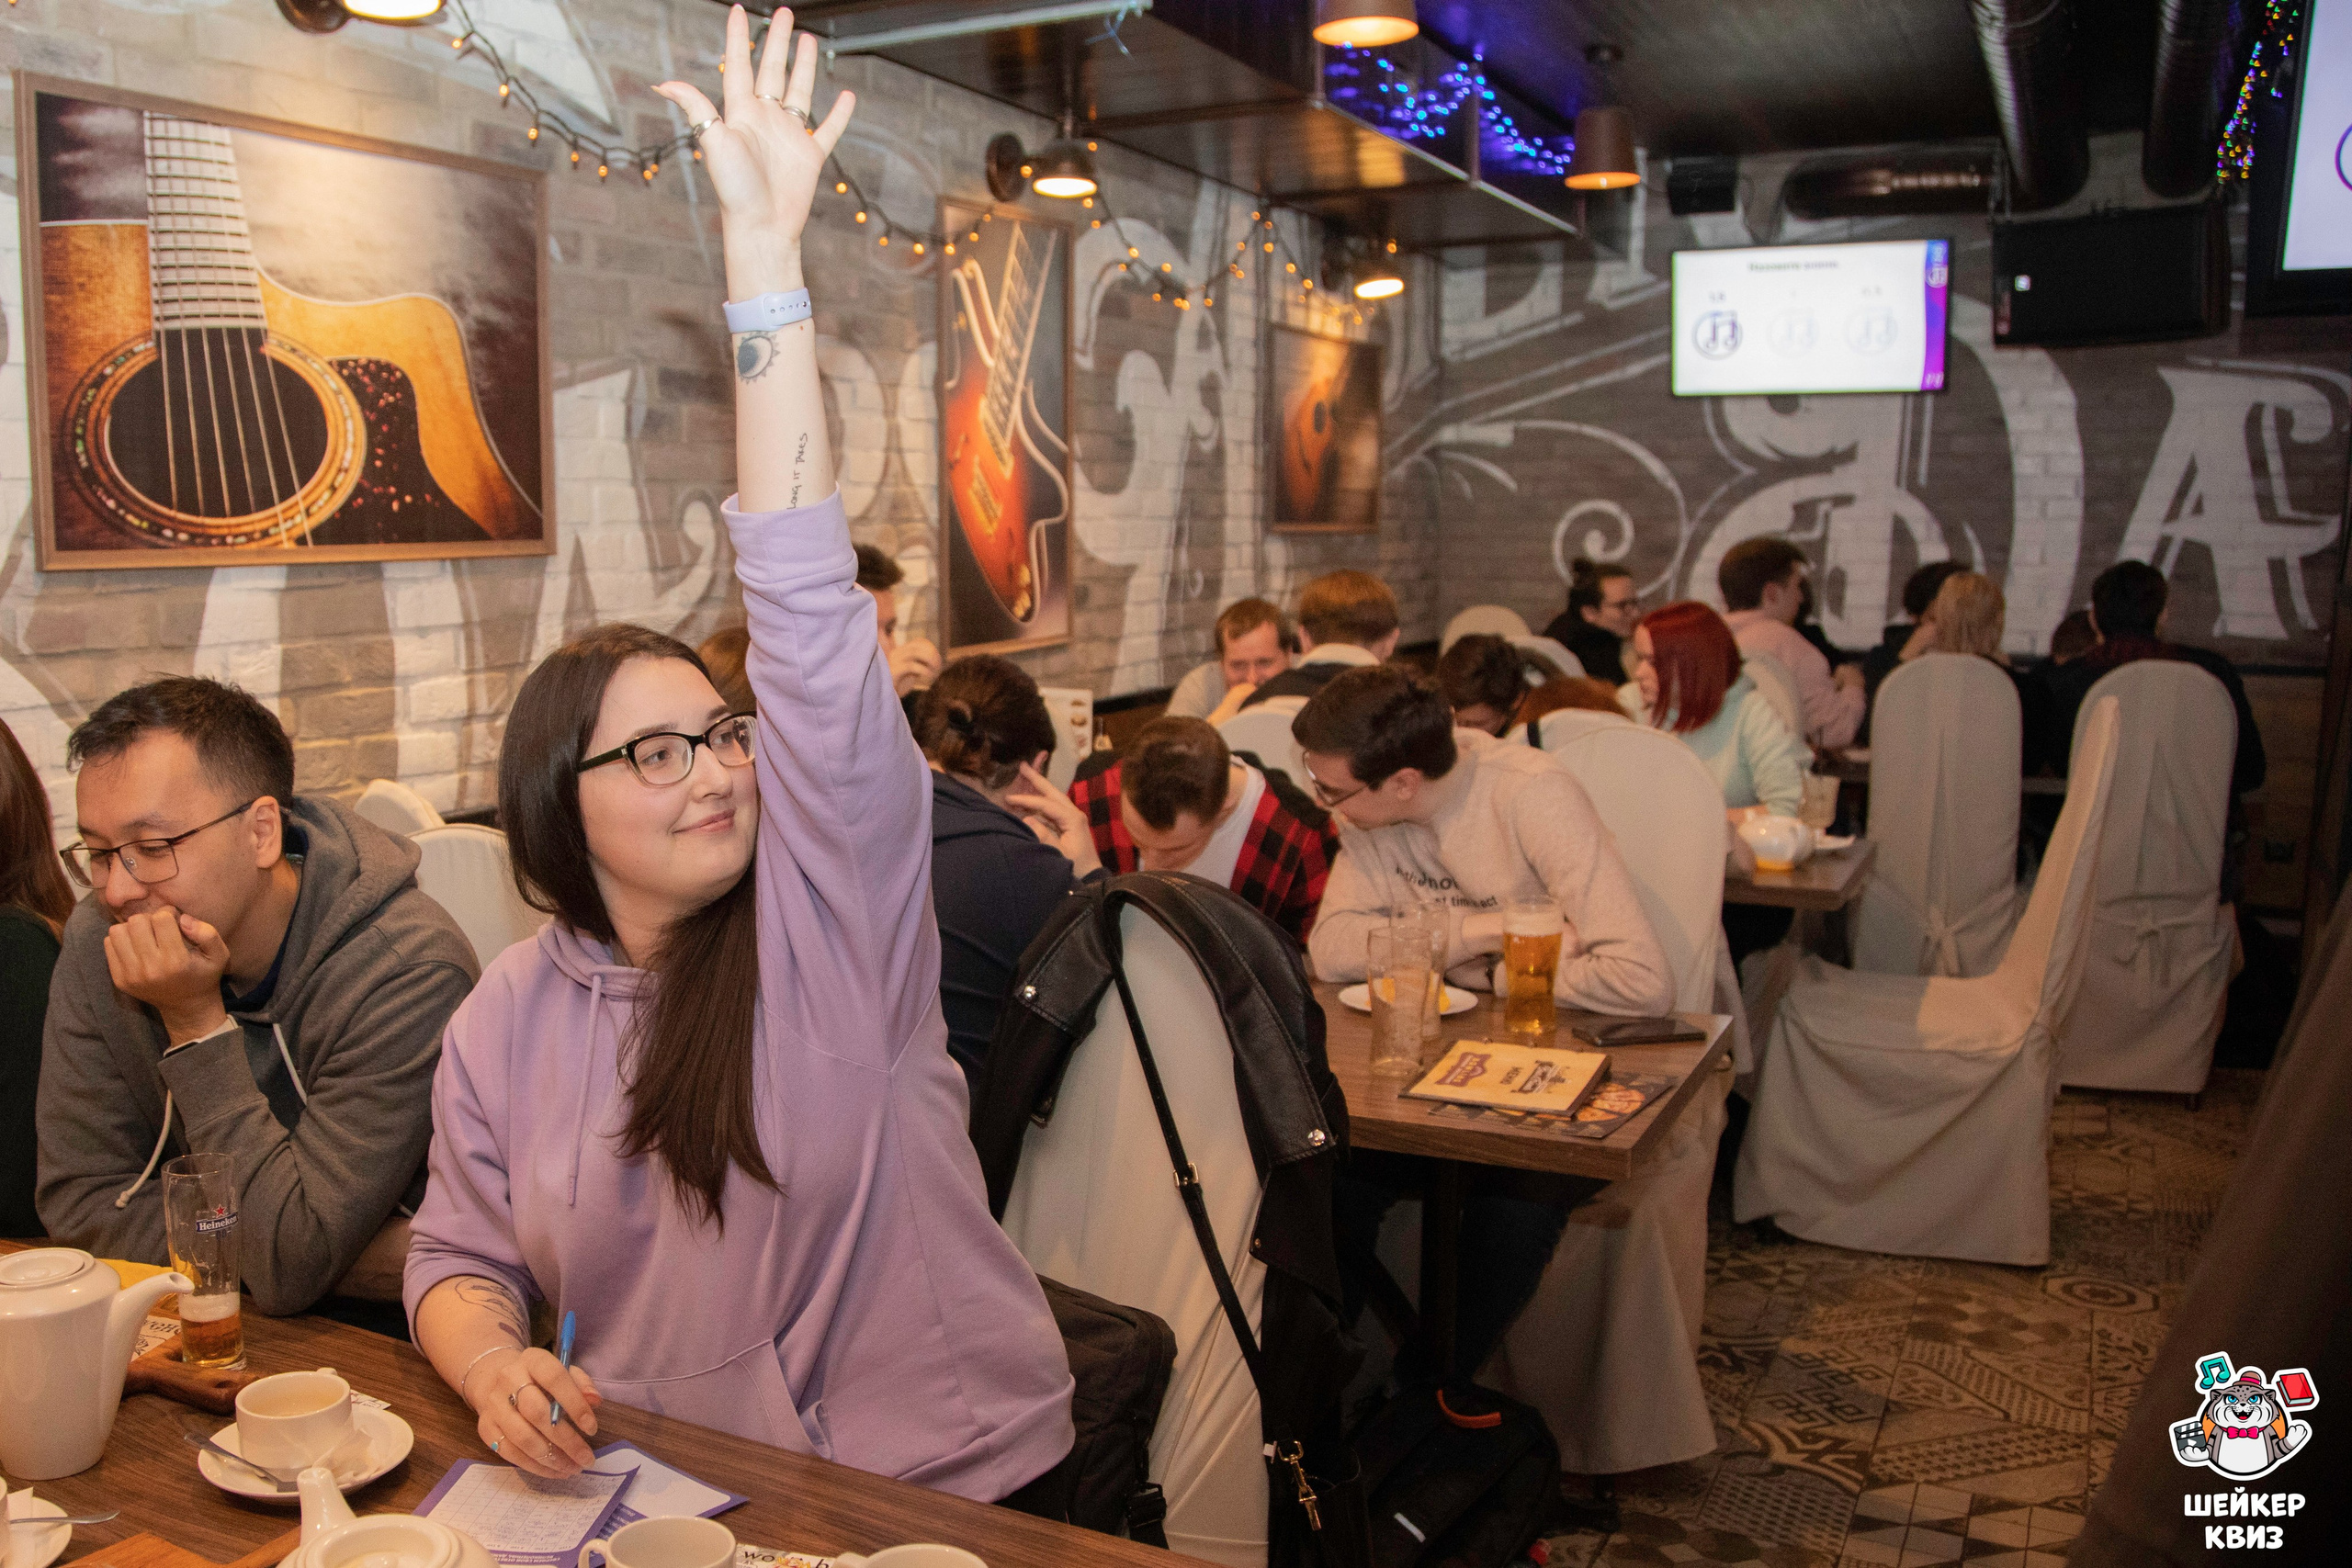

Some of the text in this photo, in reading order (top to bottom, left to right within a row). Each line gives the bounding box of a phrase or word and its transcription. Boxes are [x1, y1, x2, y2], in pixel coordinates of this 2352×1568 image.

[786, 433, 808, 510] LONG IT TAKES
[199, 1216, 238, 1231] Heineken
